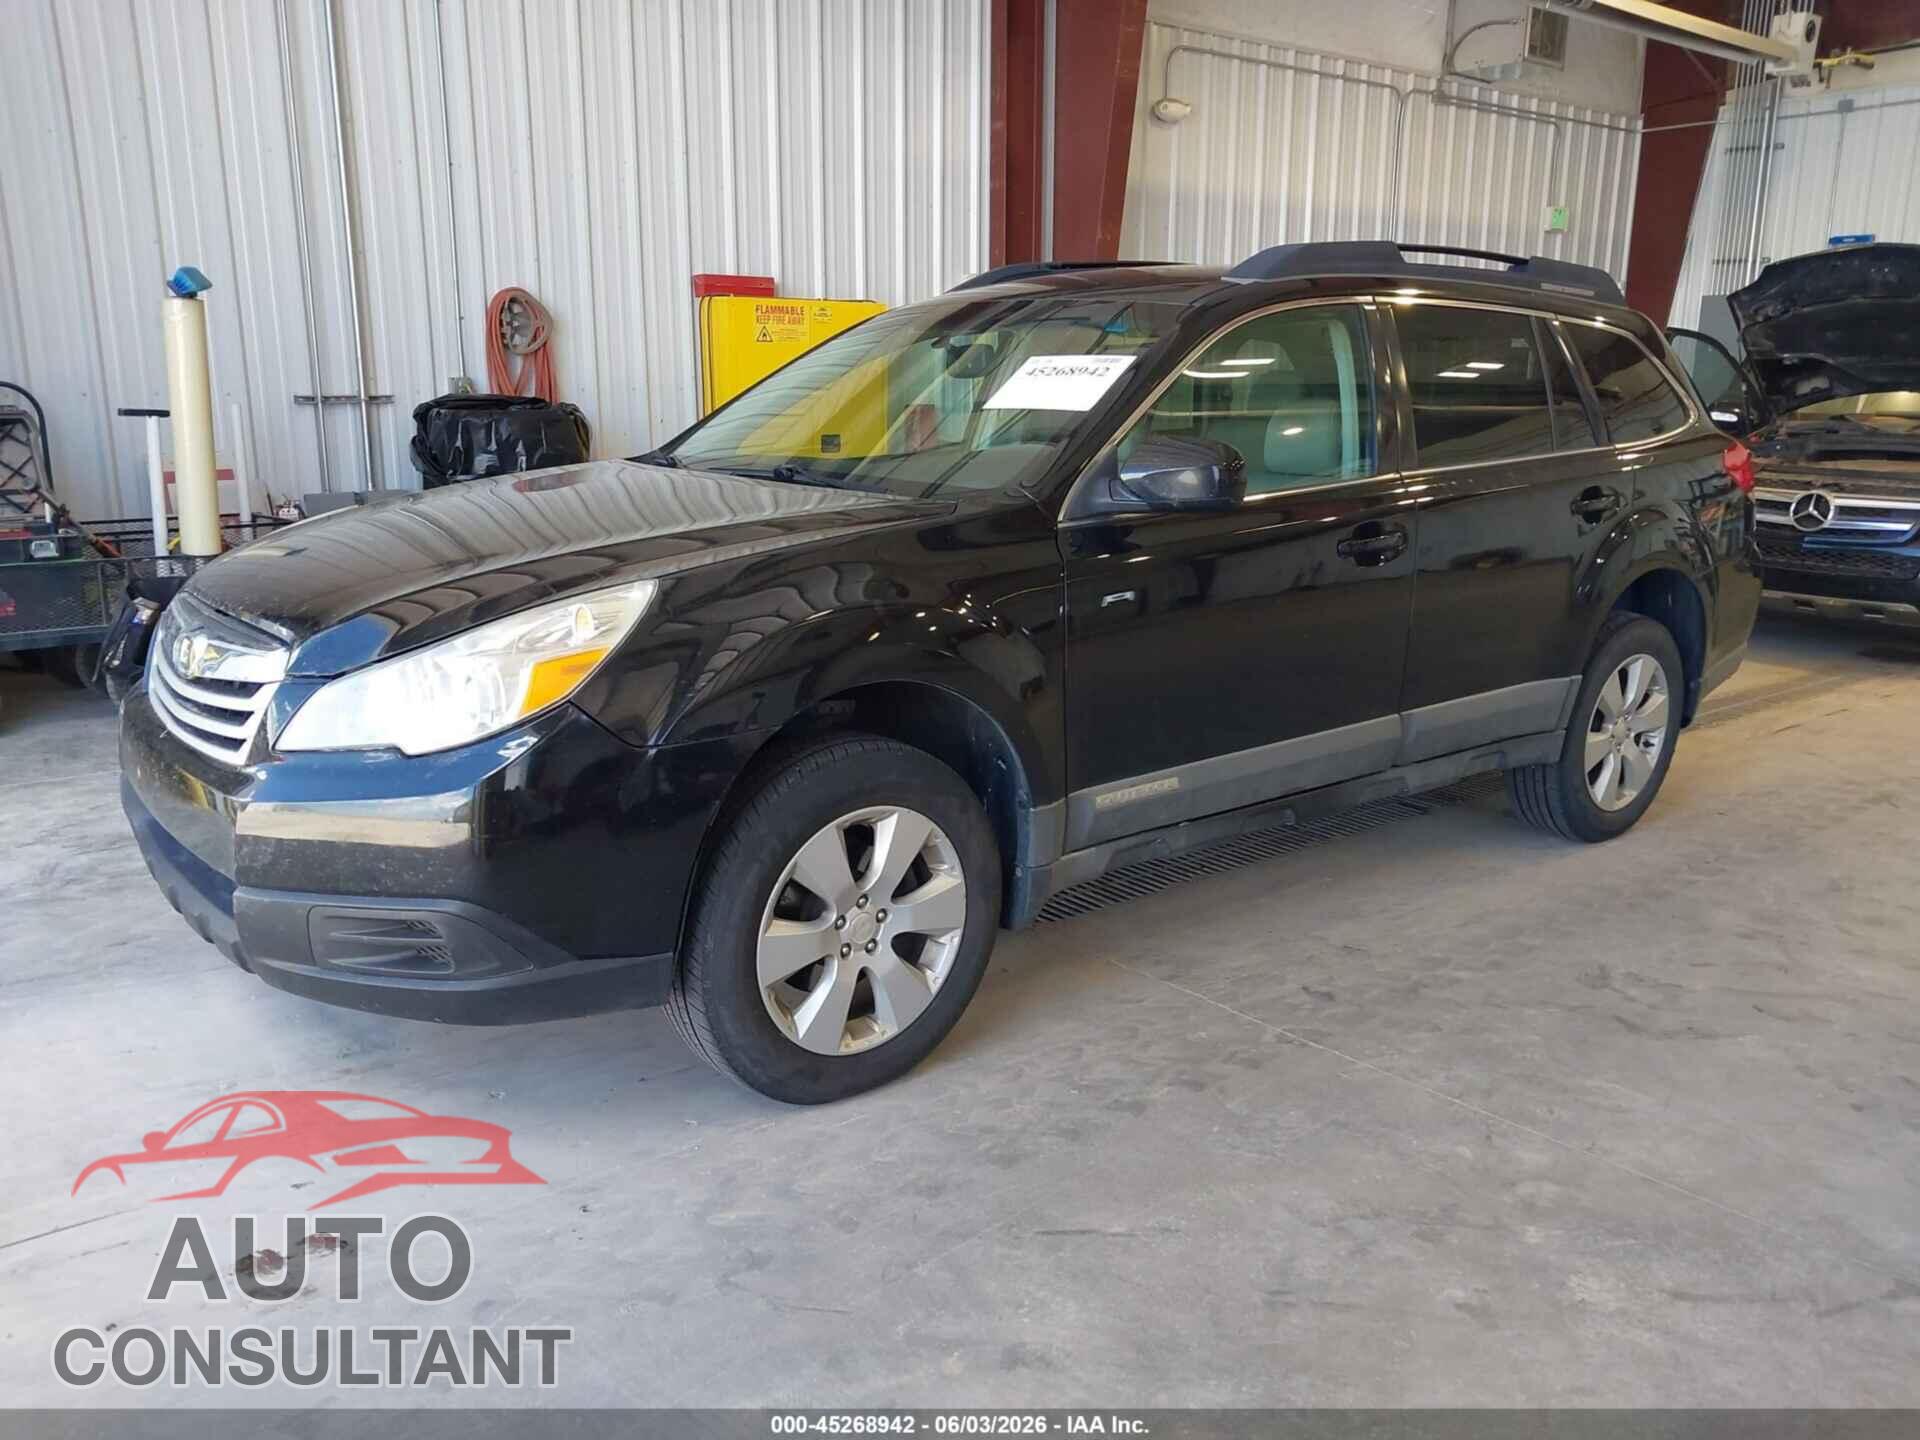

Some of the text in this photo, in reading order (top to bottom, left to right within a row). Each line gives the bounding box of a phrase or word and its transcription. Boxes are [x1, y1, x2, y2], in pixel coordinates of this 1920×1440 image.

[755, 304, 805, 316] FLAMMABLE
[756, 315, 771, 325] KEEP
[1026, 366, 1110, 377] 45268942
